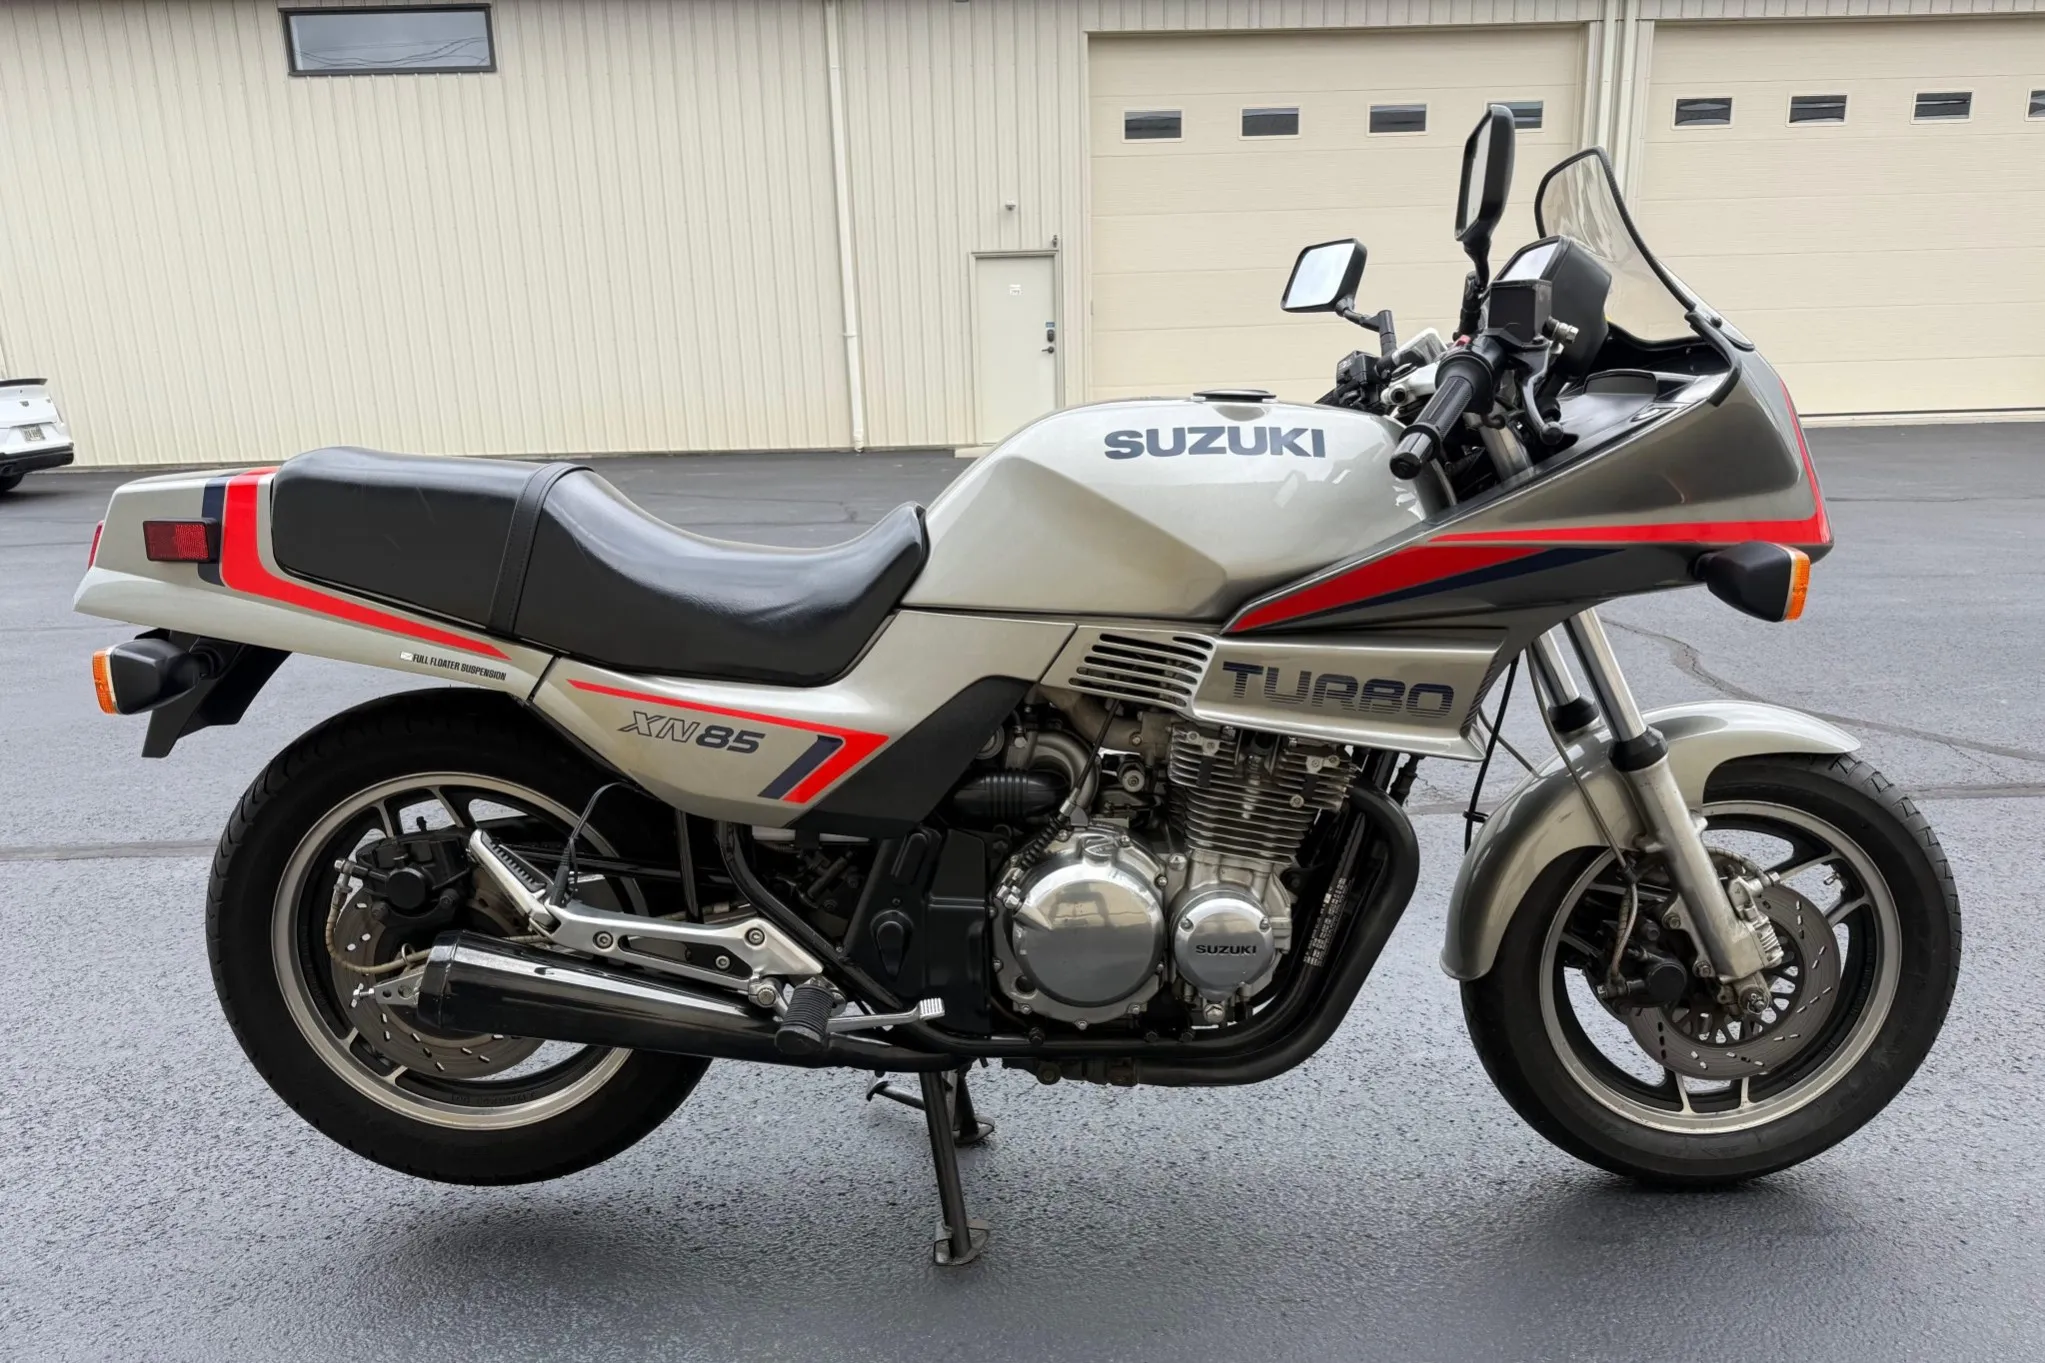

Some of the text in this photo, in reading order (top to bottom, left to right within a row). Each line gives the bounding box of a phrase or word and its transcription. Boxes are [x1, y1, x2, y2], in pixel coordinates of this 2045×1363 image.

[1104, 426, 1326, 460] SUZUKI
[412, 653, 507, 681] FULL FLOATER SUSPENSION
[1222, 661, 1455, 719] TURBO
[617, 710, 766, 754] XN85
[1195, 944, 1257, 955] SUZUKI
